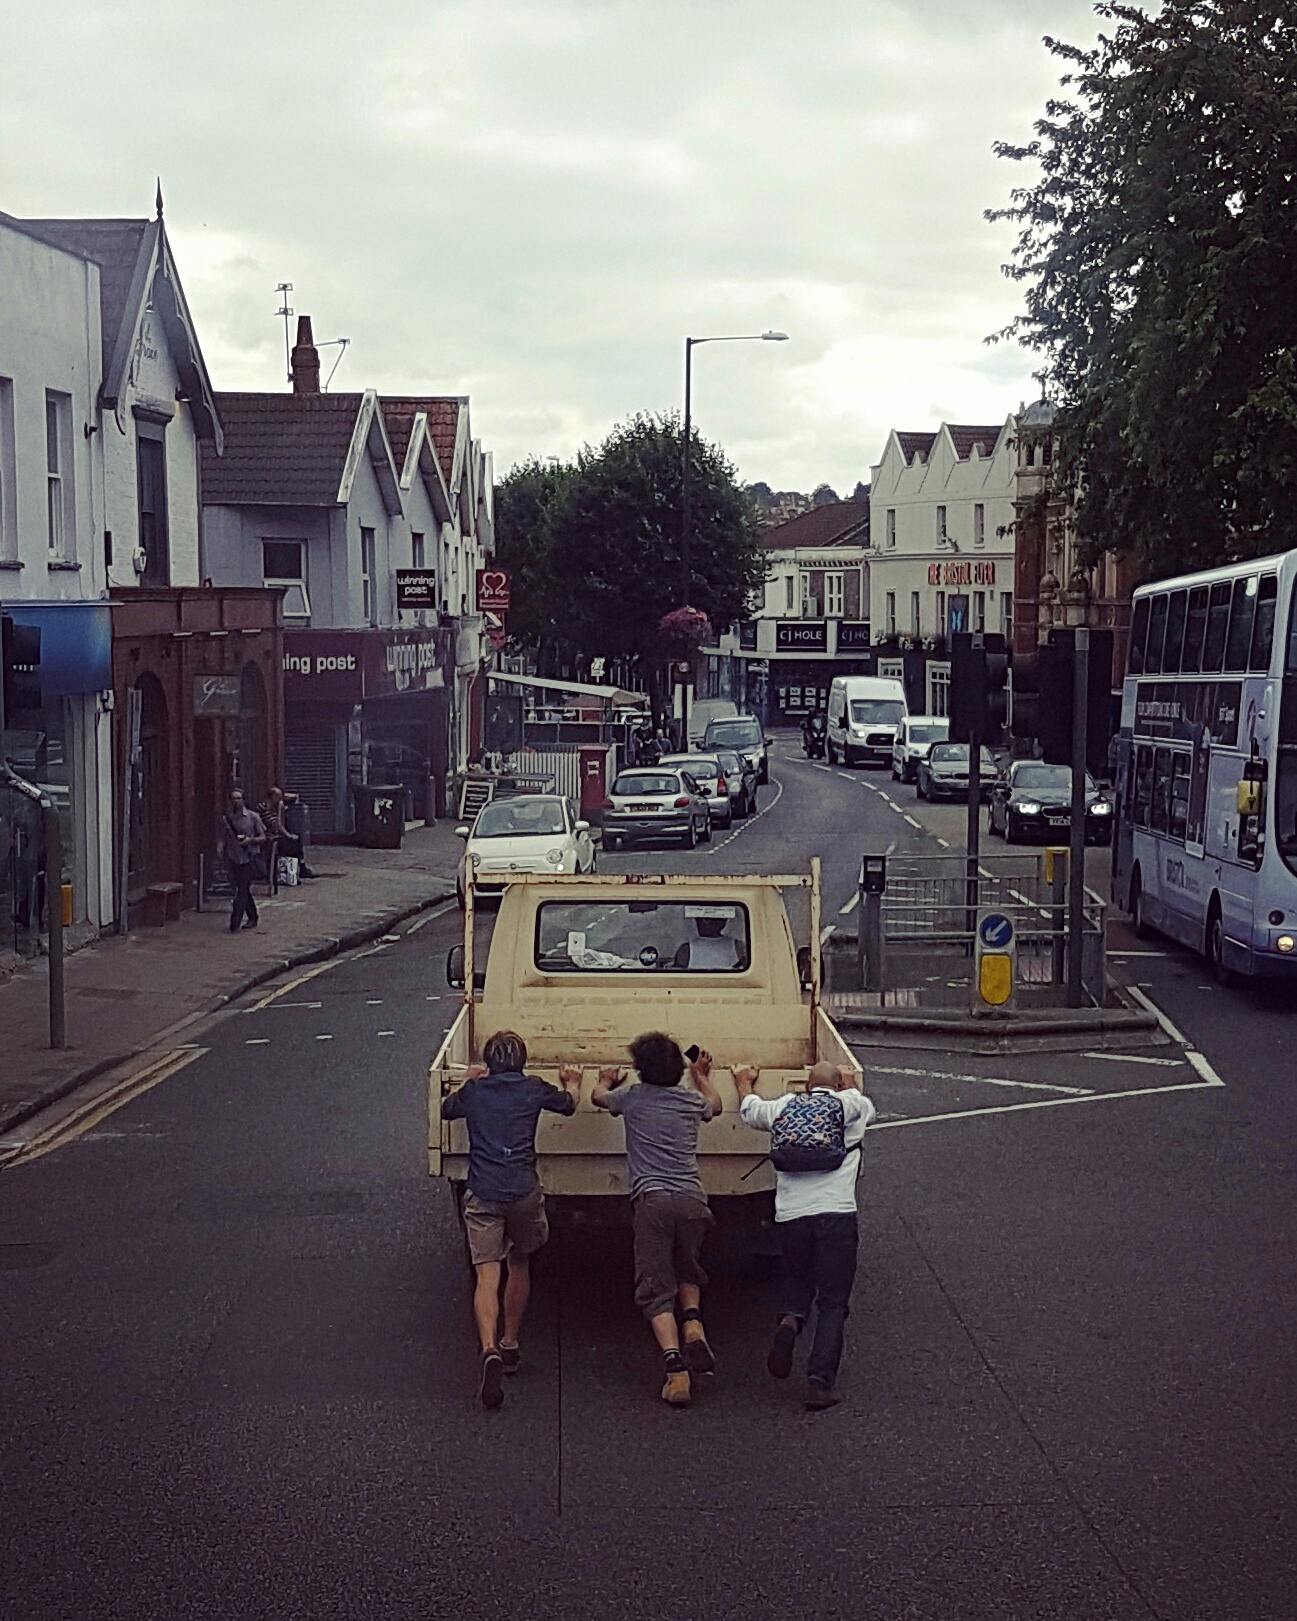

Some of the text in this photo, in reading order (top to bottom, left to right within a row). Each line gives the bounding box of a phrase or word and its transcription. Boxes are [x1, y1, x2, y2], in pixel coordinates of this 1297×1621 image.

[397, 575, 435, 587] winning
[404, 586, 428, 596] post
[794, 630, 823, 640] HOLE
[386, 635, 436, 678] winning post
[282, 653, 356, 675] ing post
